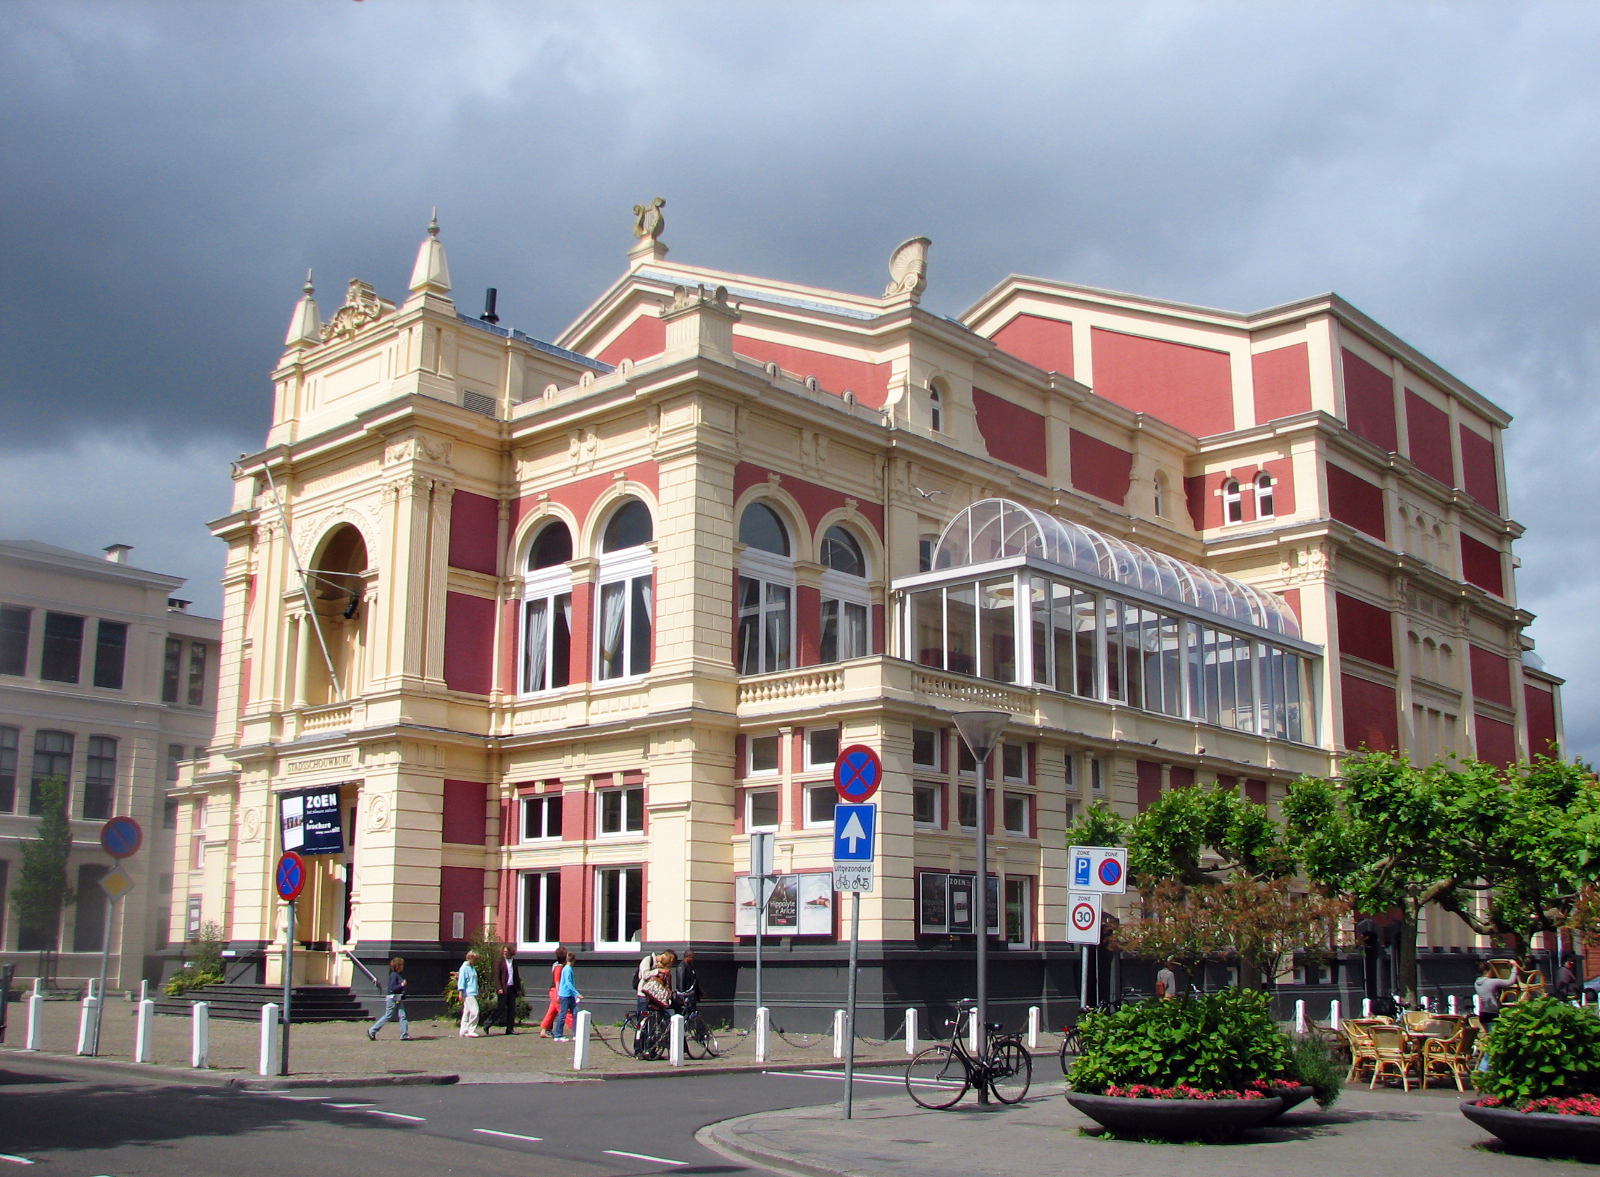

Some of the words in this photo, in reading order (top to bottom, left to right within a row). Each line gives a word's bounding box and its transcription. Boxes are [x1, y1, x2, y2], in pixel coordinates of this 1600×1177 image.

[288, 756, 352, 772] STADSSCHOUWBURG
[306, 794, 336, 808] ZOEN
[834, 865, 871, 874] uitgezonderd
[1078, 860, 1087, 874] P
[770, 900, 796, 909] Hippolyte
[1077, 912, 1091, 922] 30
